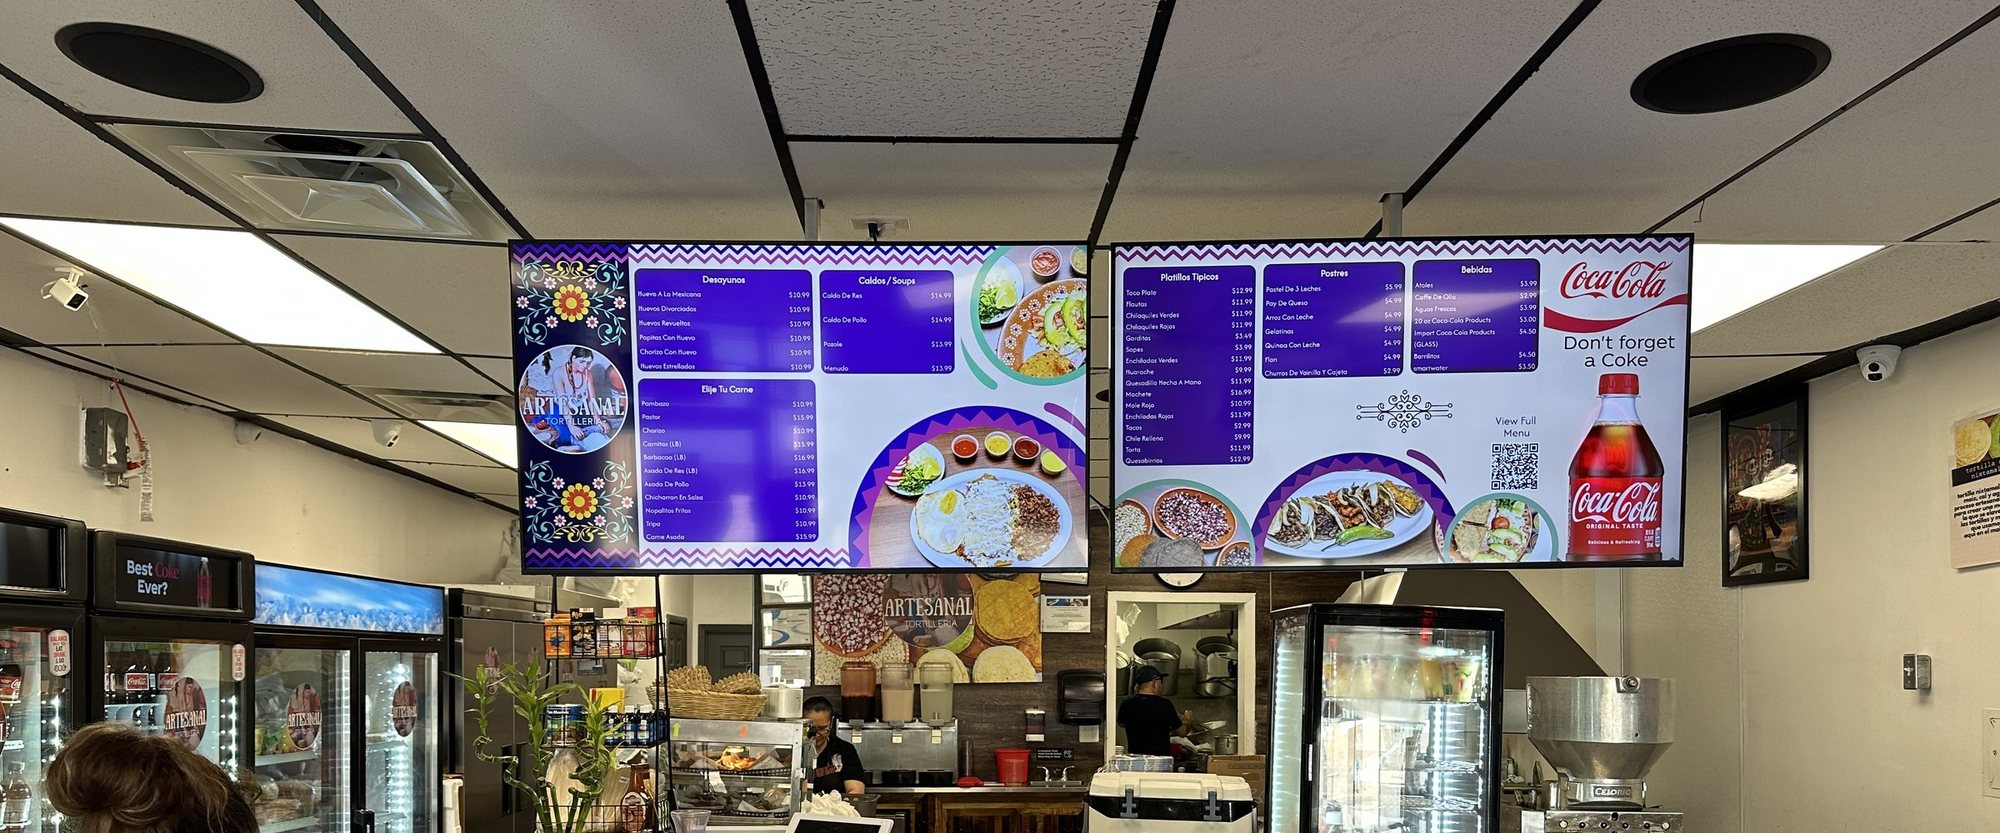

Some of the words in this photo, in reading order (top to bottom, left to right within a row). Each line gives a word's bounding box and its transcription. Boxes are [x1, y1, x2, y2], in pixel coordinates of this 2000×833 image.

[703, 276, 745, 285] Desayunos
[887, 276, 891, 285] /
[893, 277, 915, 286] Soups
[1192, 273, 1218, 282] Tipicos
[1560, 262, 1673, 298] Coca-Cola
[1565, 336, 1612, 349] Don't
[1619, 335, 1675, 352] forget
[1585, 357, 1595, 366] a
[1602, 353, 1648, 366] Coke
[702, 385, 717, 395] Elije
[523, 398, 624, 415] ARTESANAL
[1496, 417, 1518, 425] View
[1572, 482, 1661, 523] Coca-Cola
[127, 560, 152, 576] Best
[155, 562, 180, 579] Coke
[138, 579, 168, 595] Ever?
[884, 597, 972, 616] ARTESANAL
[166, 710, 206, 730] ARTESANAL
